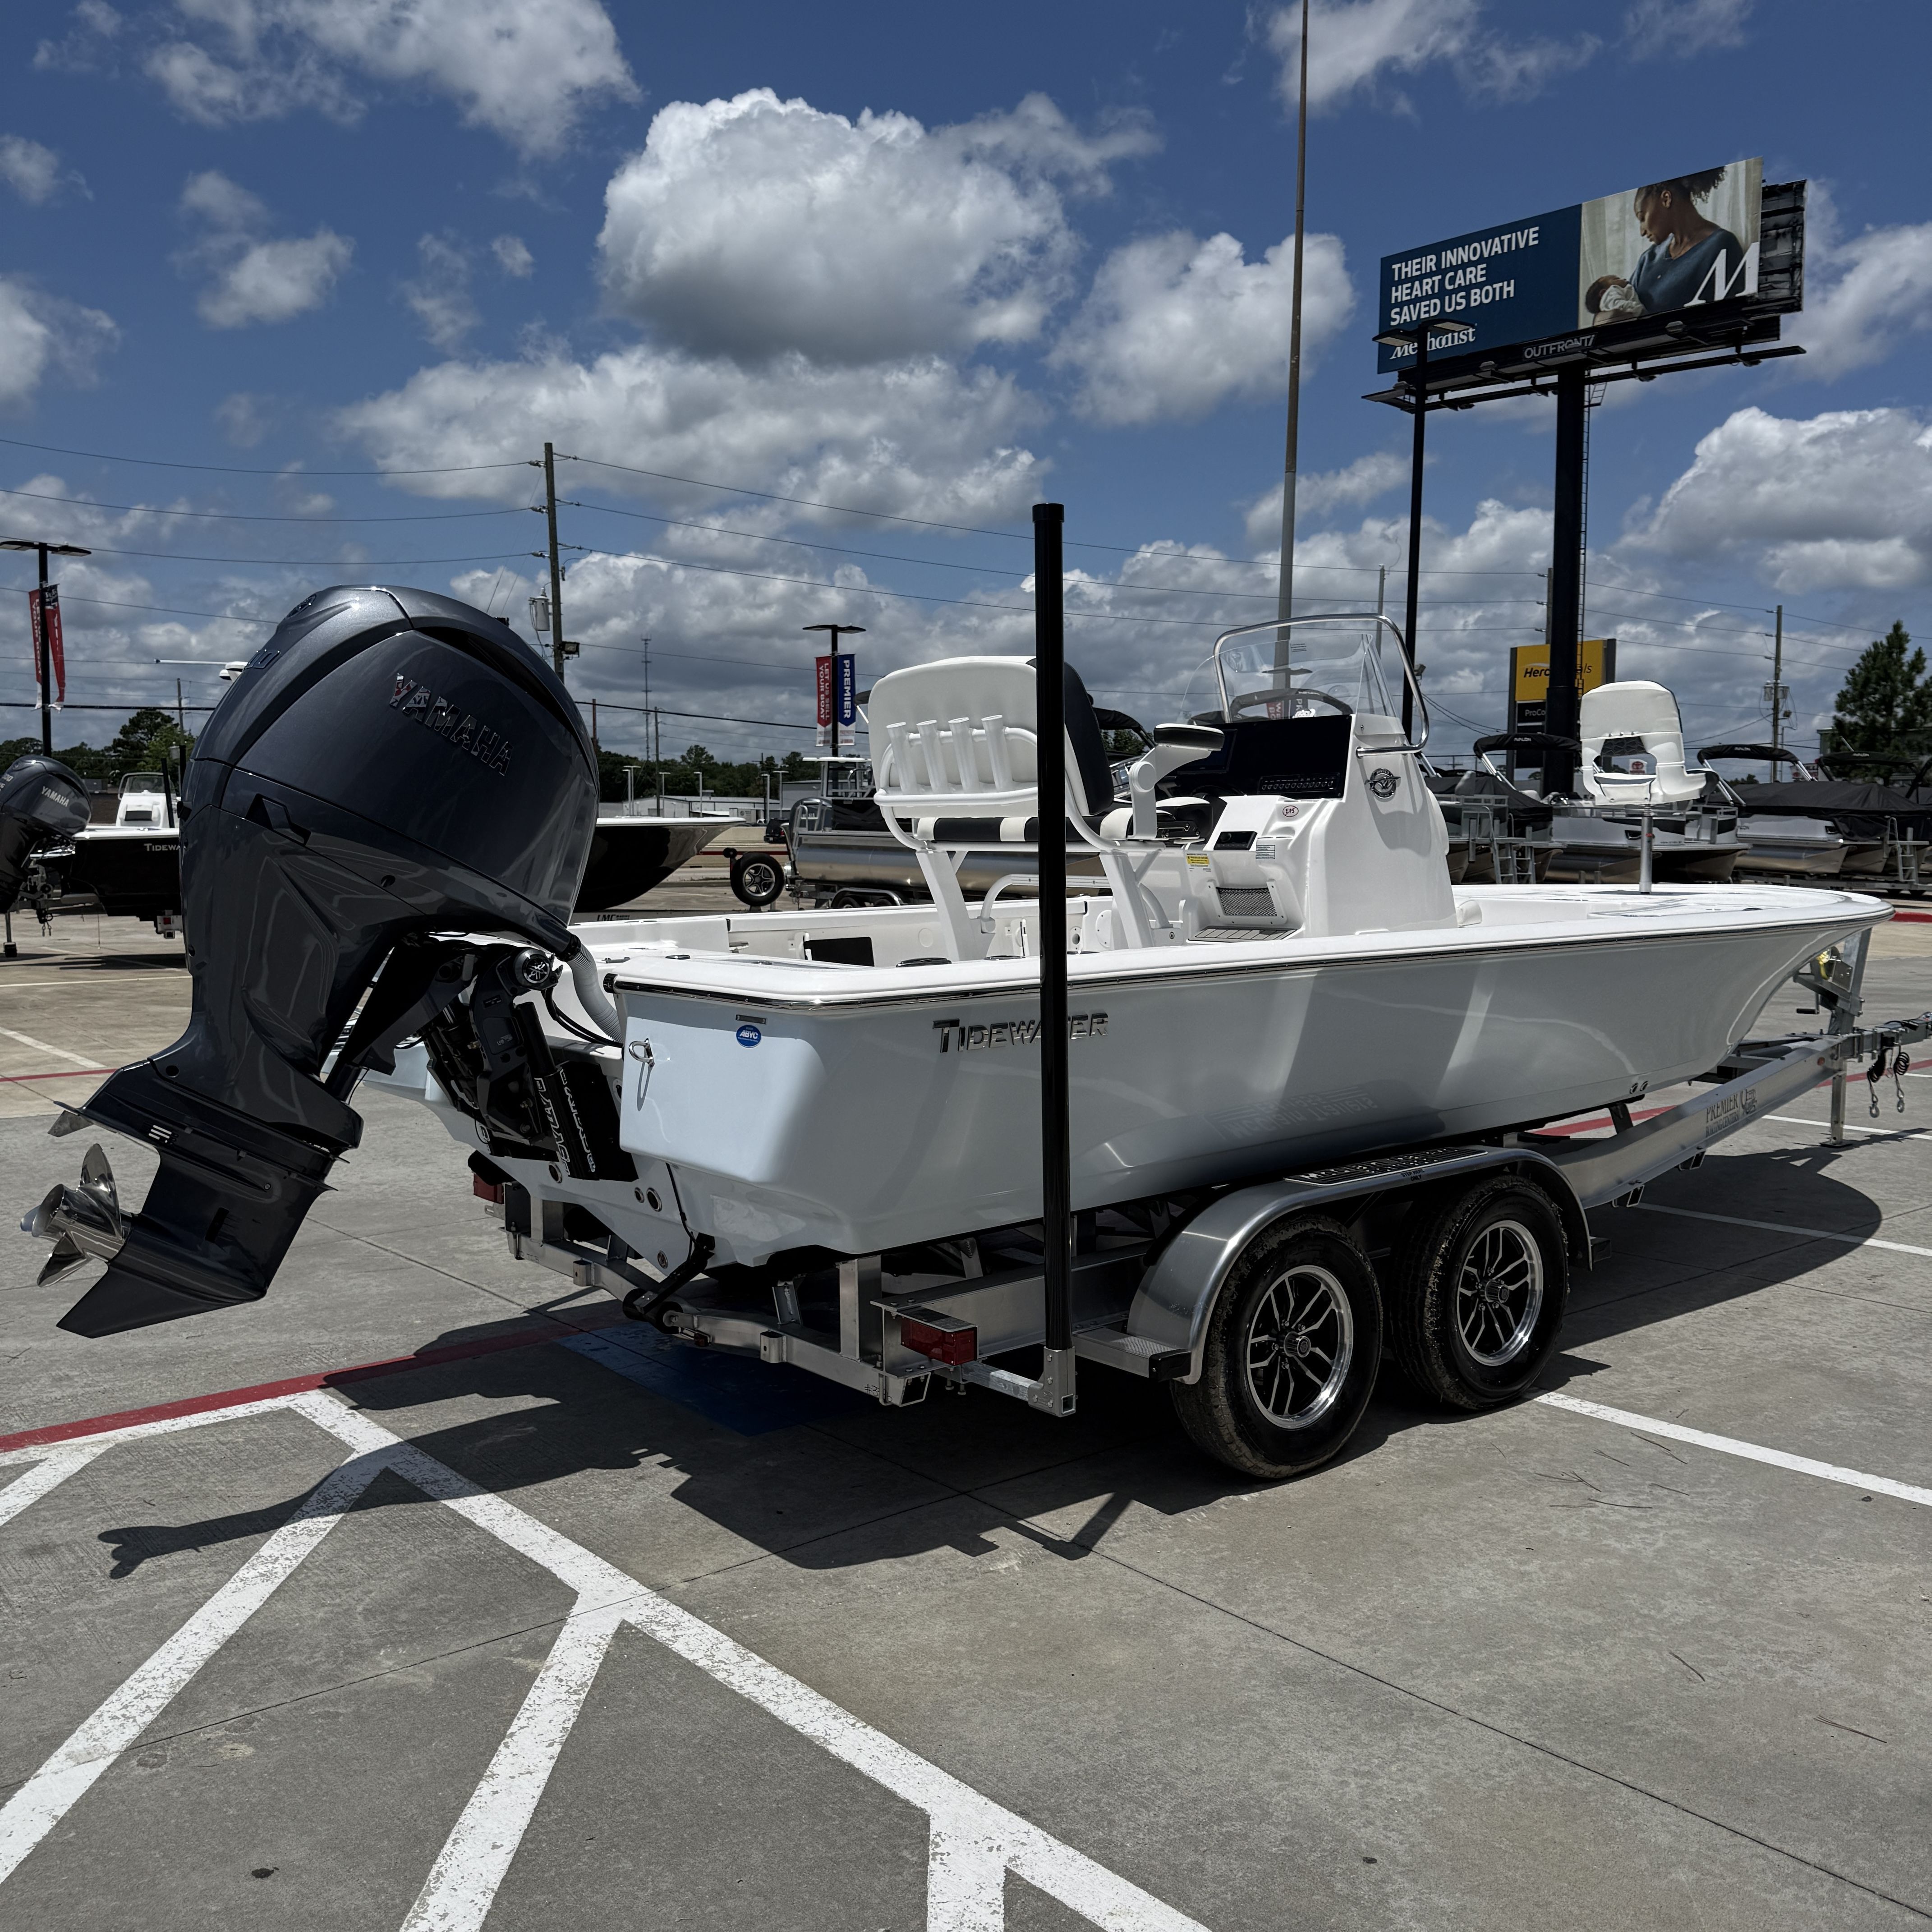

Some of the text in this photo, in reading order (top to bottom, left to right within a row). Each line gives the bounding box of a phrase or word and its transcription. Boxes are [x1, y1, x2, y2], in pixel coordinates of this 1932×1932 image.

[1392, 226, 1539, 281] THEIR INNOVATIVE
[1391, 263, 1487, 304] HEART CARE
[1390, 280, 1514, 326] SAVED US BOTH
[1389, 328, 1476, 359] Mehodist
[825, 683, 829, 695] US
[389, 672, 514, 776] YAMAHA
[41, 786, 69, 807] YAMAHA
[740, 1030, 759, 1040] ABYC
[932, 1012, 1109, 1053] TIDEWER
[1706, 1093, 1739, 1123] PREMIER
